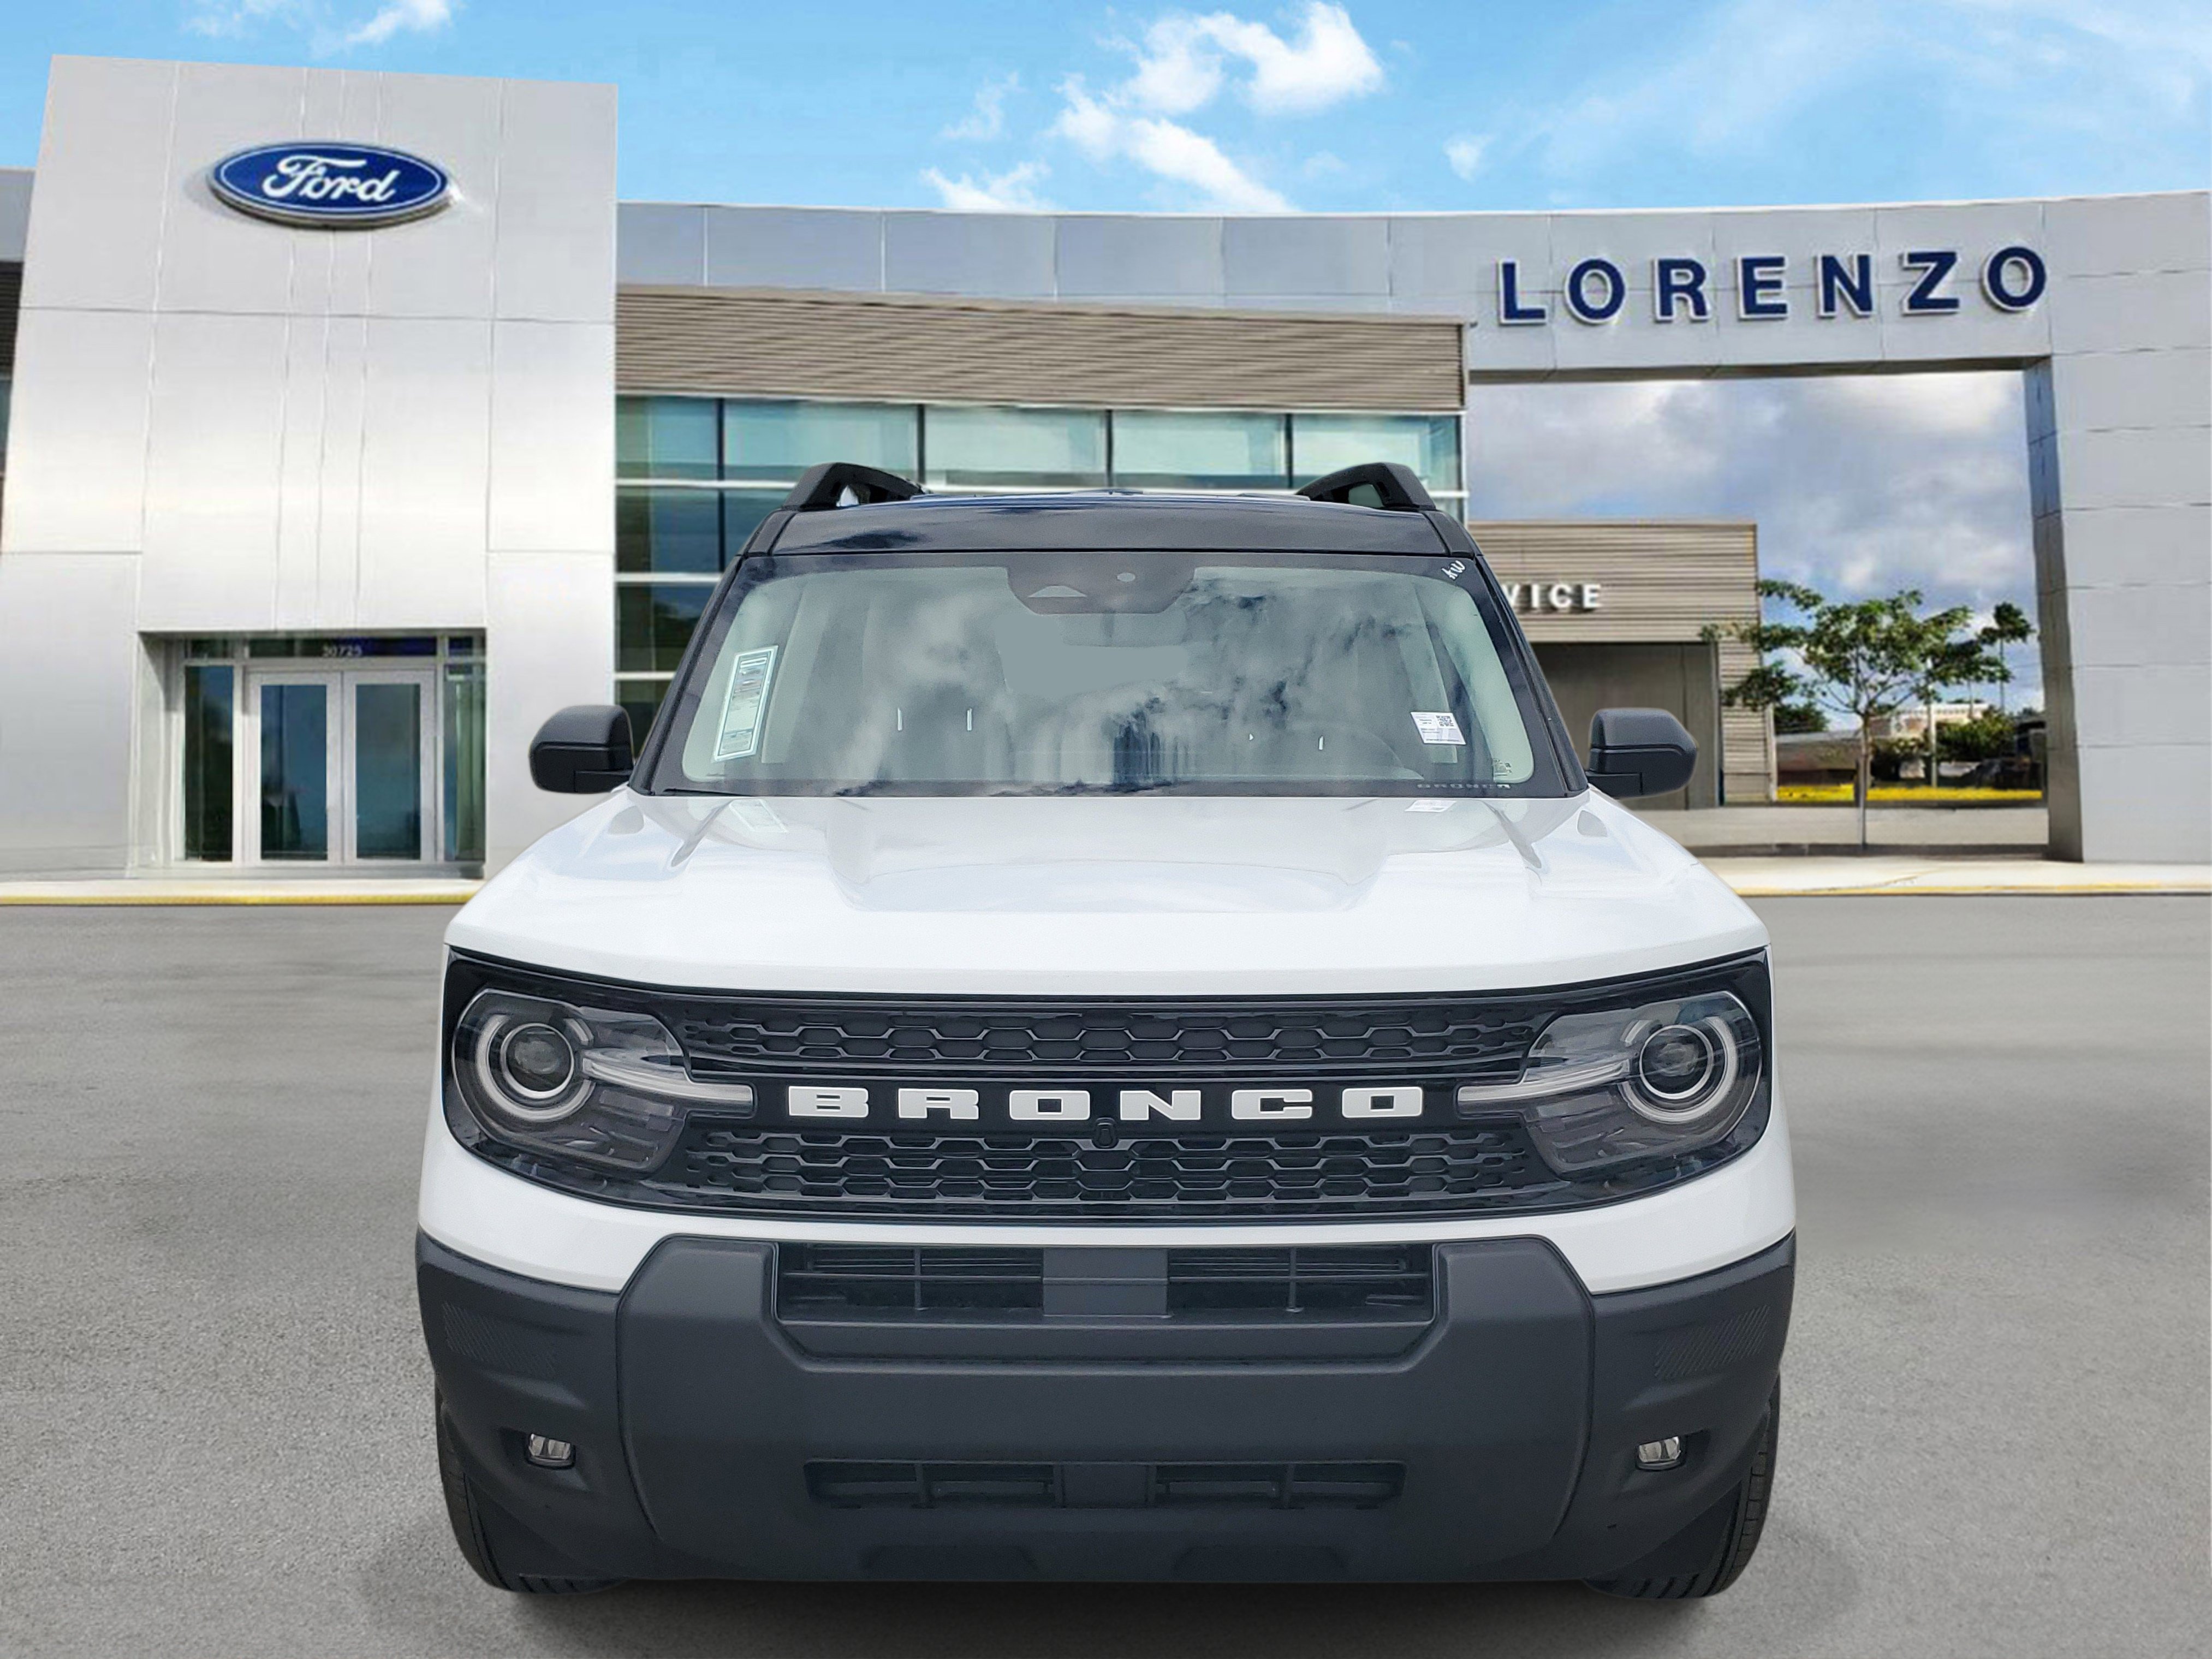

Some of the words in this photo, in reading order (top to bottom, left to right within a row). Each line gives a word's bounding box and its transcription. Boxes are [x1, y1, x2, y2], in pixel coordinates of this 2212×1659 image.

[262, 154, 400, 201] Ford
[1498, 246, 2047, 326] LORENZO
[1501, 584, 1603, 609] VICE
[787, 1086, 1423, 1121] BRONCO
